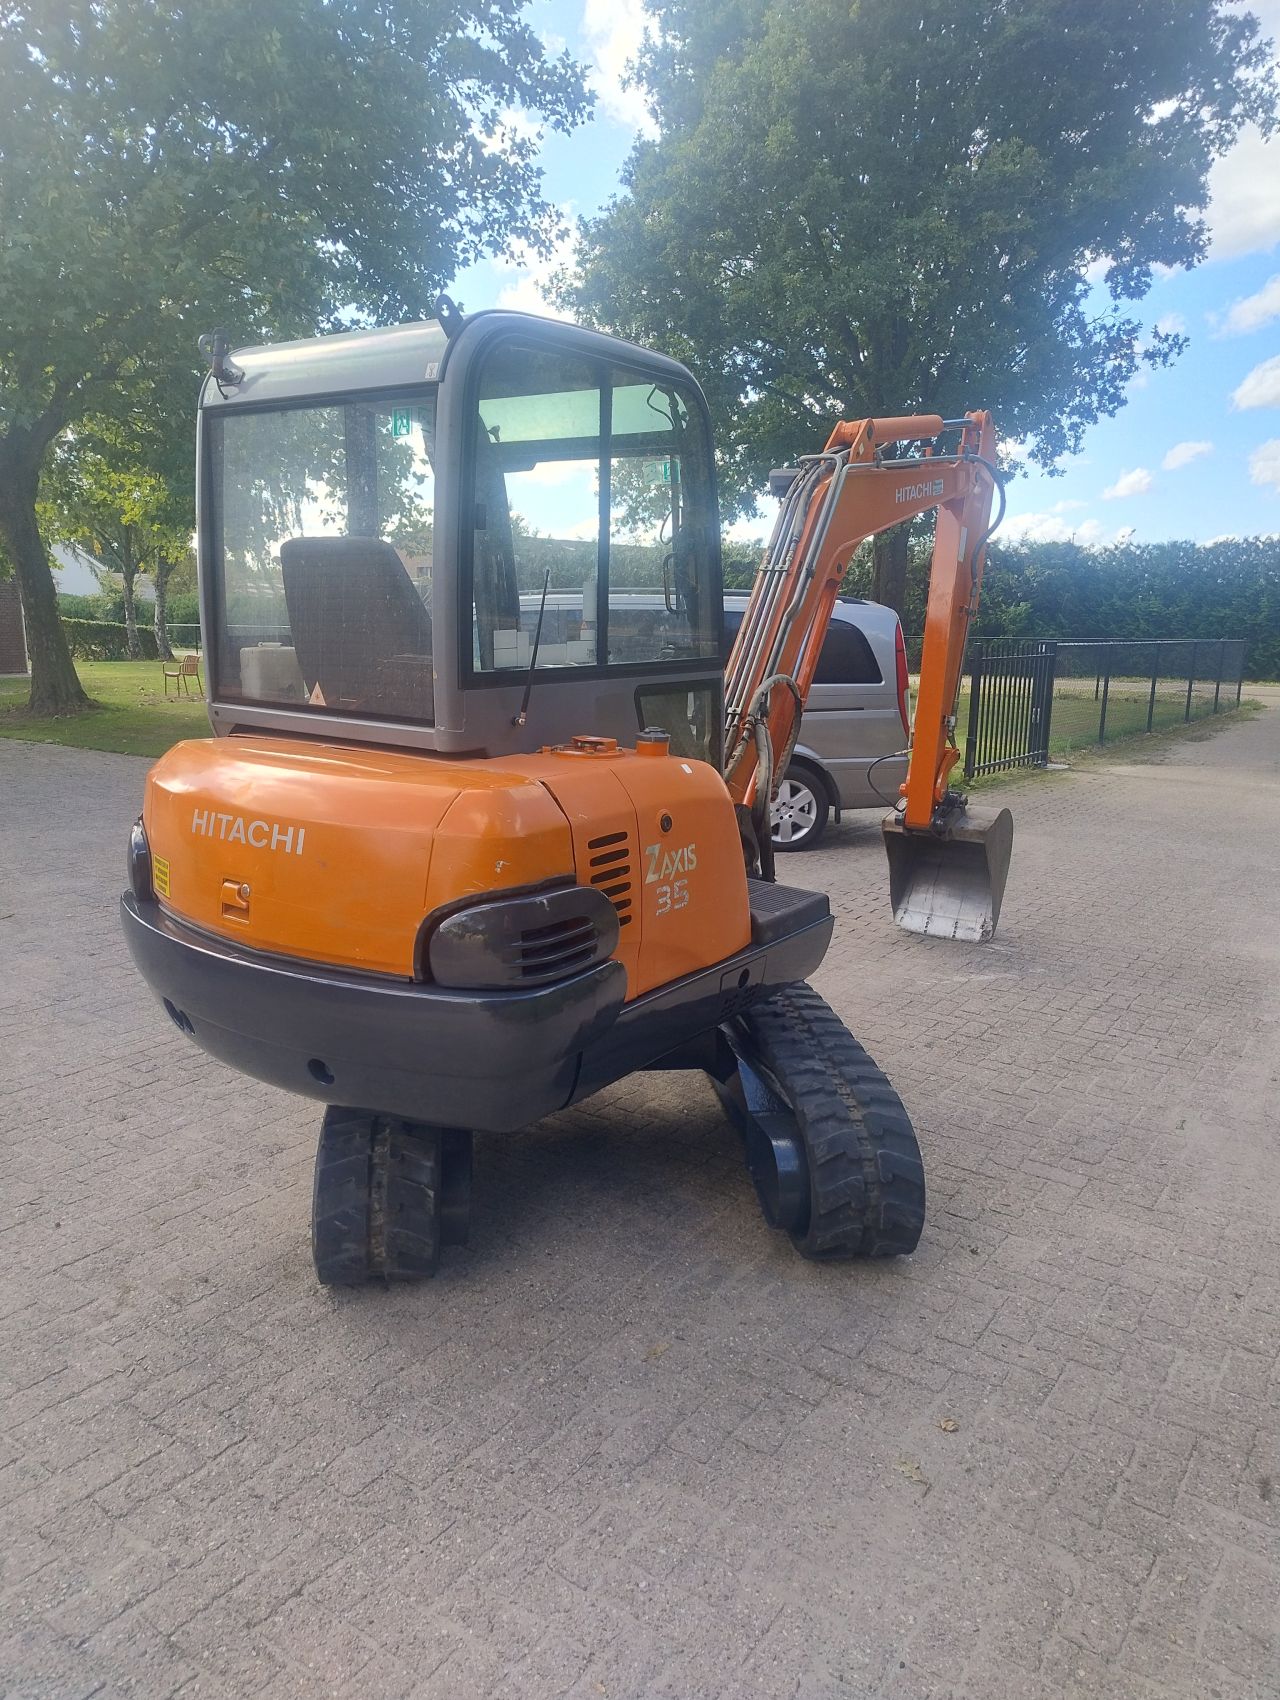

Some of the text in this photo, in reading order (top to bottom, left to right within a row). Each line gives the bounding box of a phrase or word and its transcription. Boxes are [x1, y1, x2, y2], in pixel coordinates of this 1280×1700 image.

[895, 481, 932, 504] HITACHI
[191, 808, 305, 855] HITACHI
[645, 843, 697, 884] ZAXIS
[656, 879, 689, 916] 35
